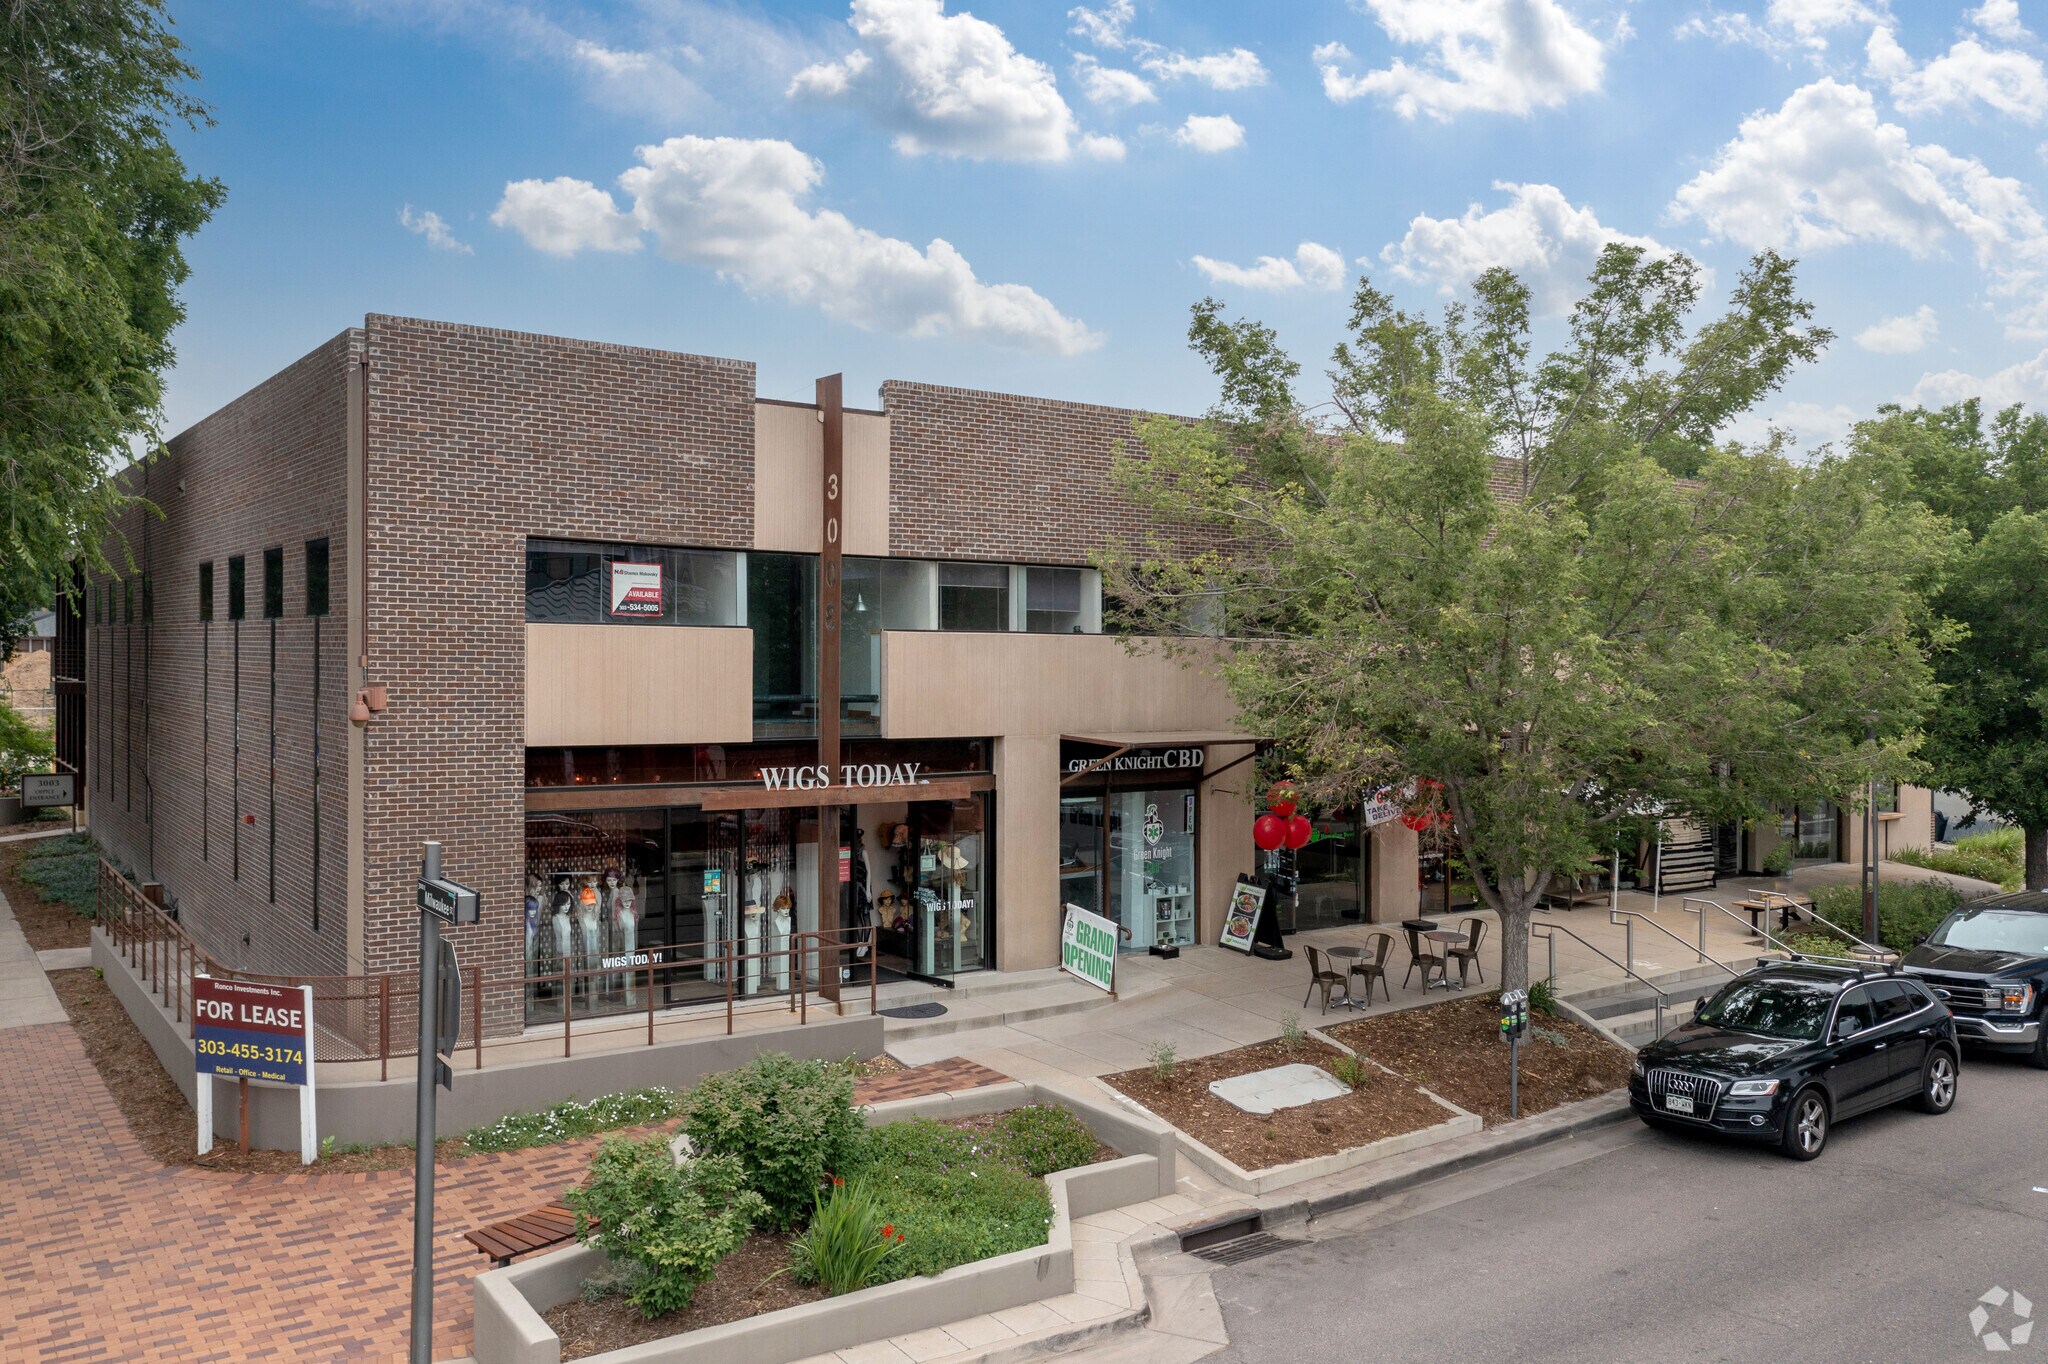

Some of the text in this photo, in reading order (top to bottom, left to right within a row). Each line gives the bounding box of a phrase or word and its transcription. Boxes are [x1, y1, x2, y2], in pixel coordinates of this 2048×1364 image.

[759, 763, 921, 791] WIGS TODAY
[1367, 804, 1388, 815] TAKE
[1133, 846, 1172, 861] Green Knight
[1076, 920, 1115, 958] GRAND
[602, 952, 663, 968] WIGS TODY!
[1064, 941, 1112, 986] OPENING
[214, 982, 283, 996] Ronco Investments Inc.
[196, 999, 302, 1029] FOR LEASE
[198, 1039, 303, 1065] 303-455-3174
[215, 1065, 233, 1074] Retail
[238, 1068, 257, 1077] Office
[262, 1071, 286, 1080] Medical
